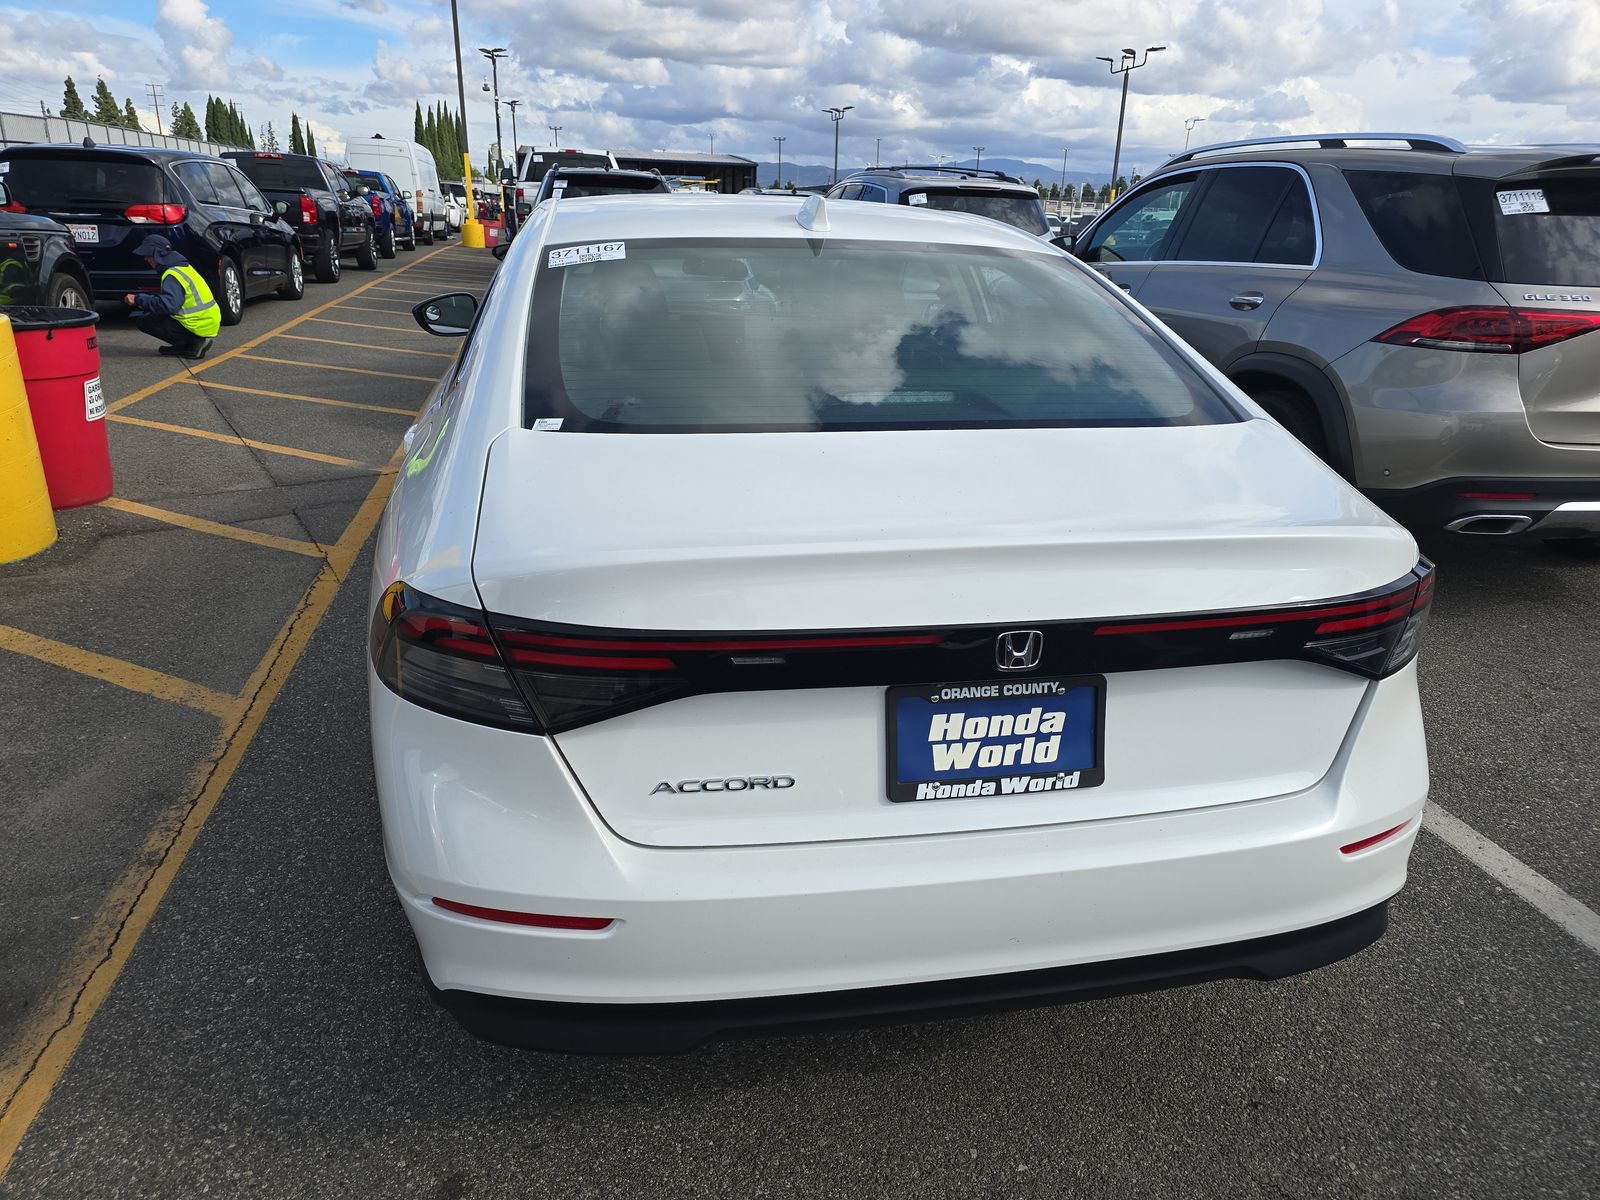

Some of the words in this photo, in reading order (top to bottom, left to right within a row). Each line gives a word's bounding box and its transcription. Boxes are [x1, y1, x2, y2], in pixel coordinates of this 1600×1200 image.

[551, 243, 624, 259] 3711167
[1523, 293, 1556, 301] GLE
[1559, 294, 1592, 302] 350
[941, 686, 999, 700] ORANGE
[1003, 682, 1060, 696] COUNTY
[928, 707, 1066, 742] Honda
[932, 735, 1061, 772] World
[649, 774, 796, 796] ACCORD
[916, 779, 996, 800] Honda
[1000, 771, 1081, 795] World
